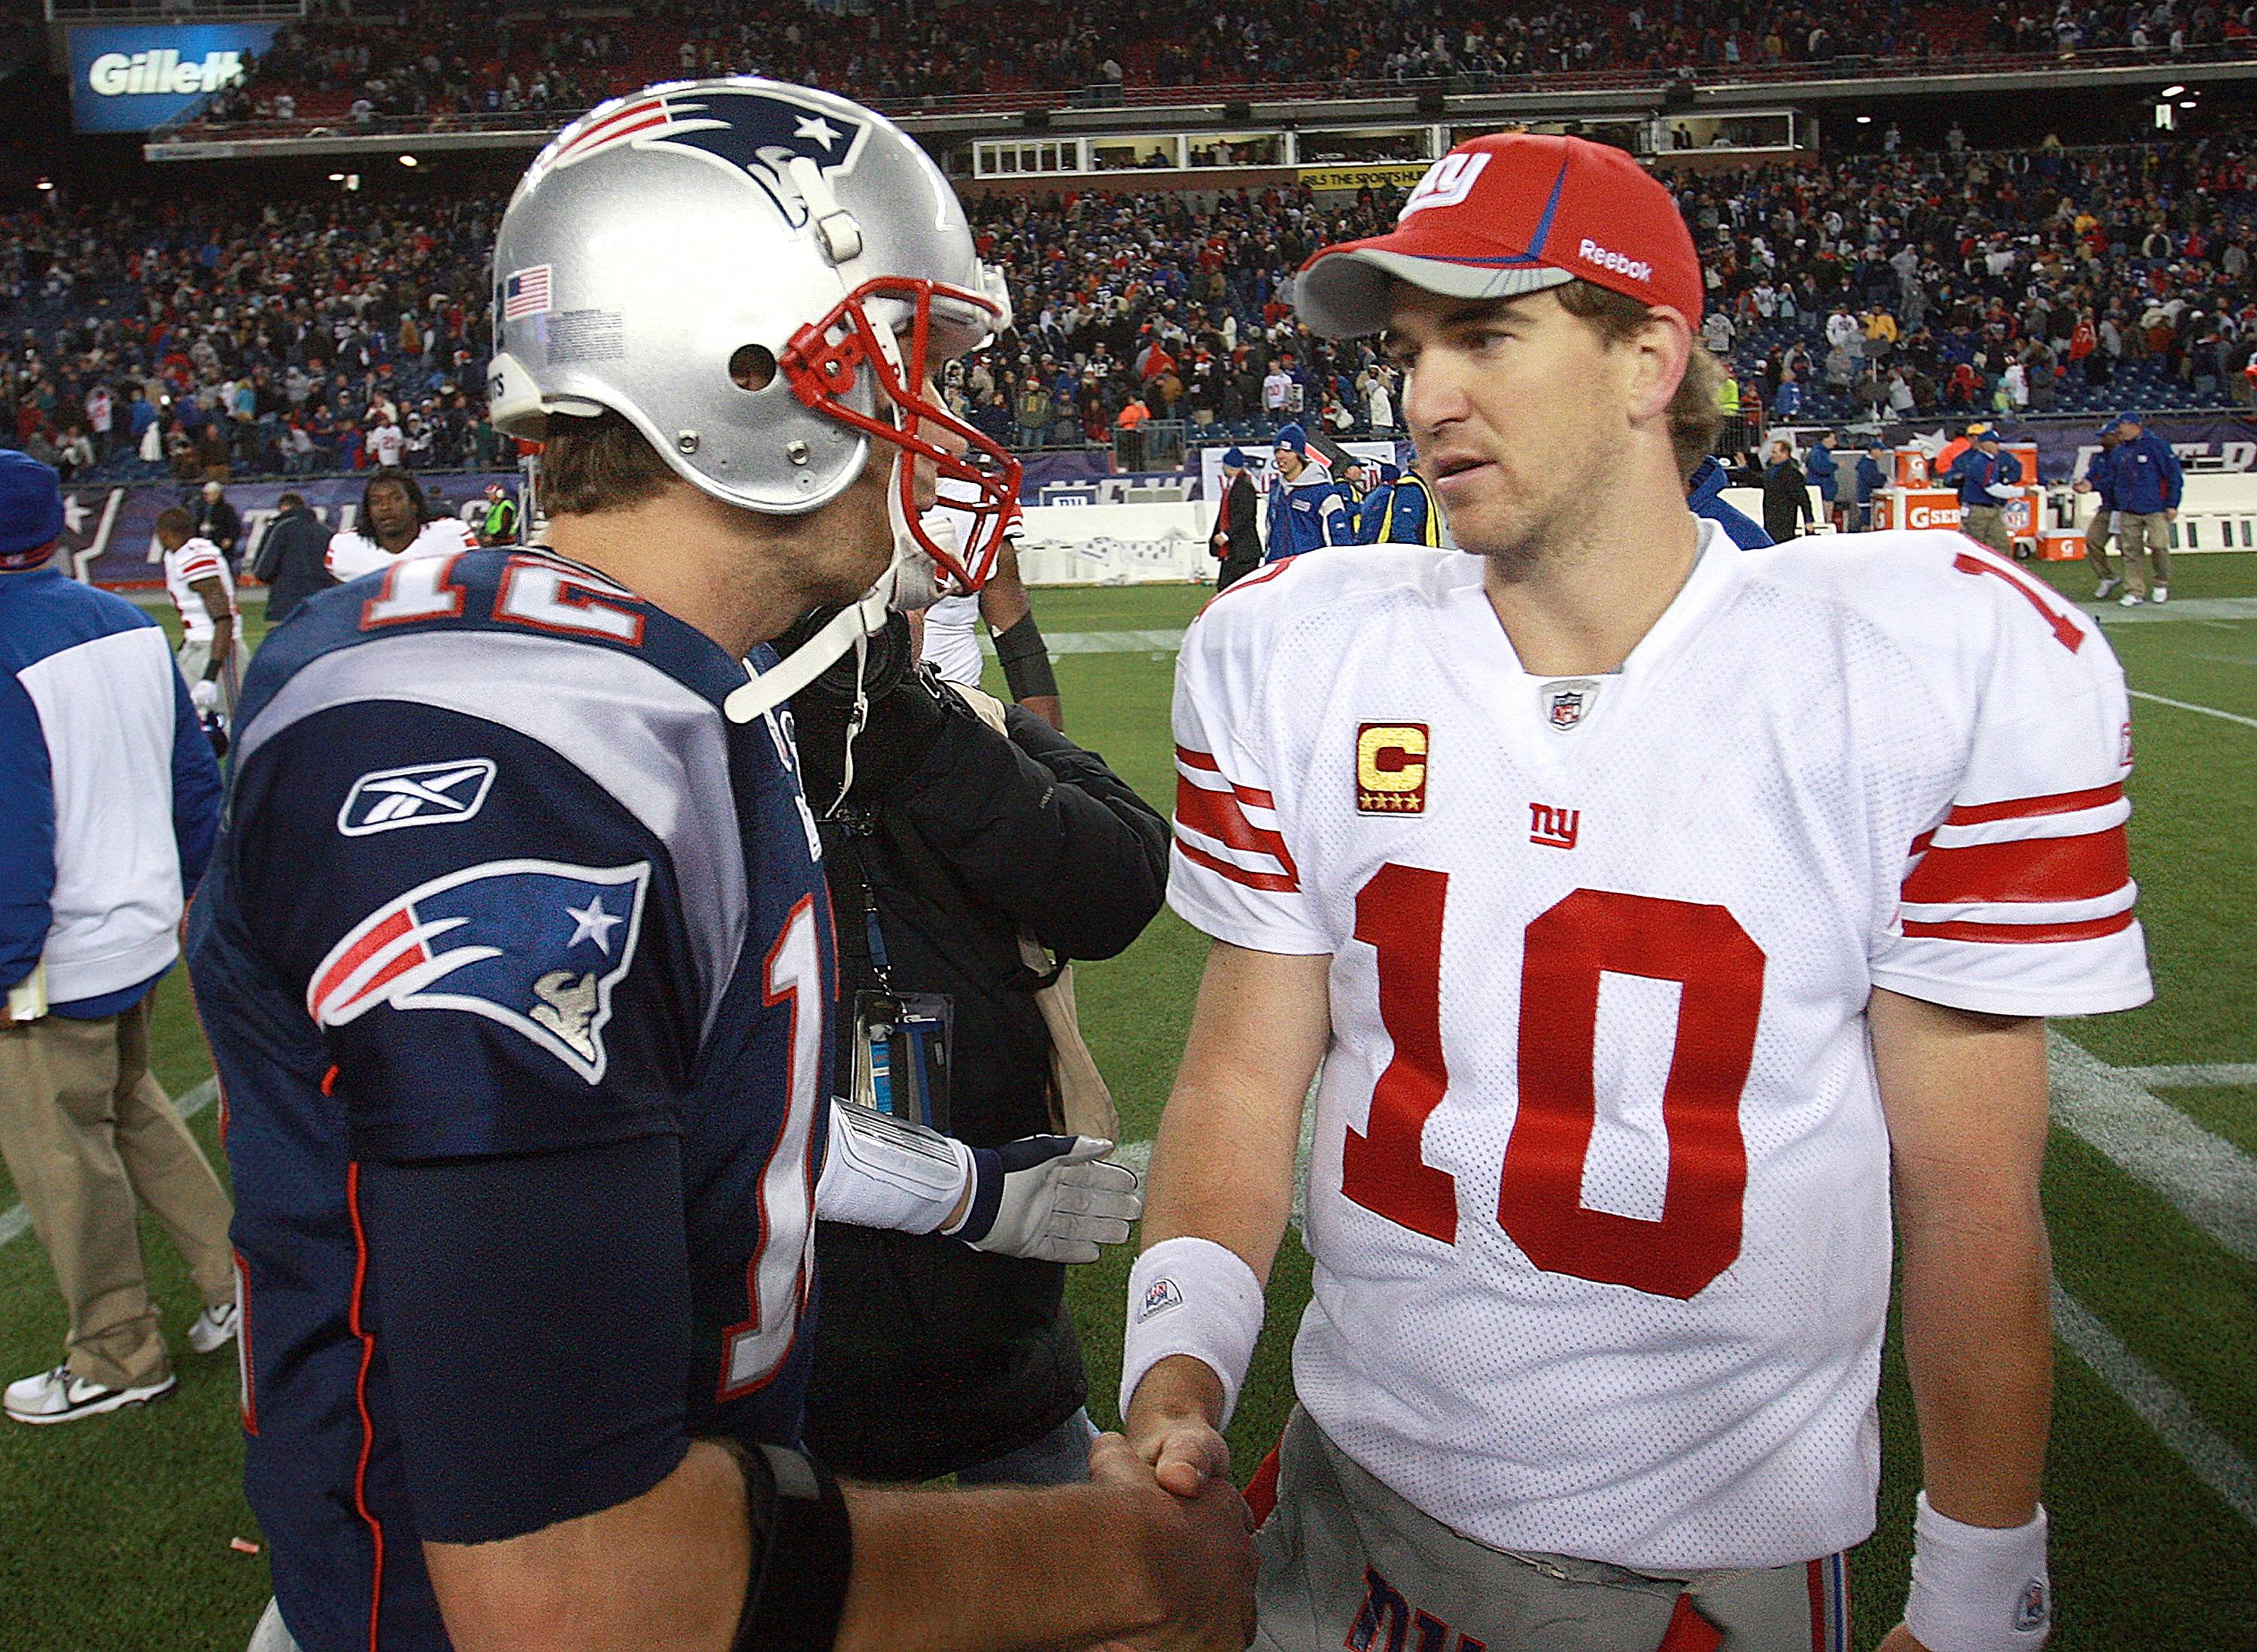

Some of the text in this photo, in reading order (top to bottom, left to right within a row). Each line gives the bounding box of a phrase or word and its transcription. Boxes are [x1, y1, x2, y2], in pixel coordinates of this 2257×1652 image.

[89, 48, 245, 96] Gillett
[1330, 172, 1353, 185] THE
[1579, 238, 1653, 283] Reebok
[1909, 506, 1930, 529] G
[2060, 539, 2074, 554] G
[358, 553, 649, 648] 12
[1357, 726, 1429, 793] C
[1342, 861, 1765, 1300] 10
